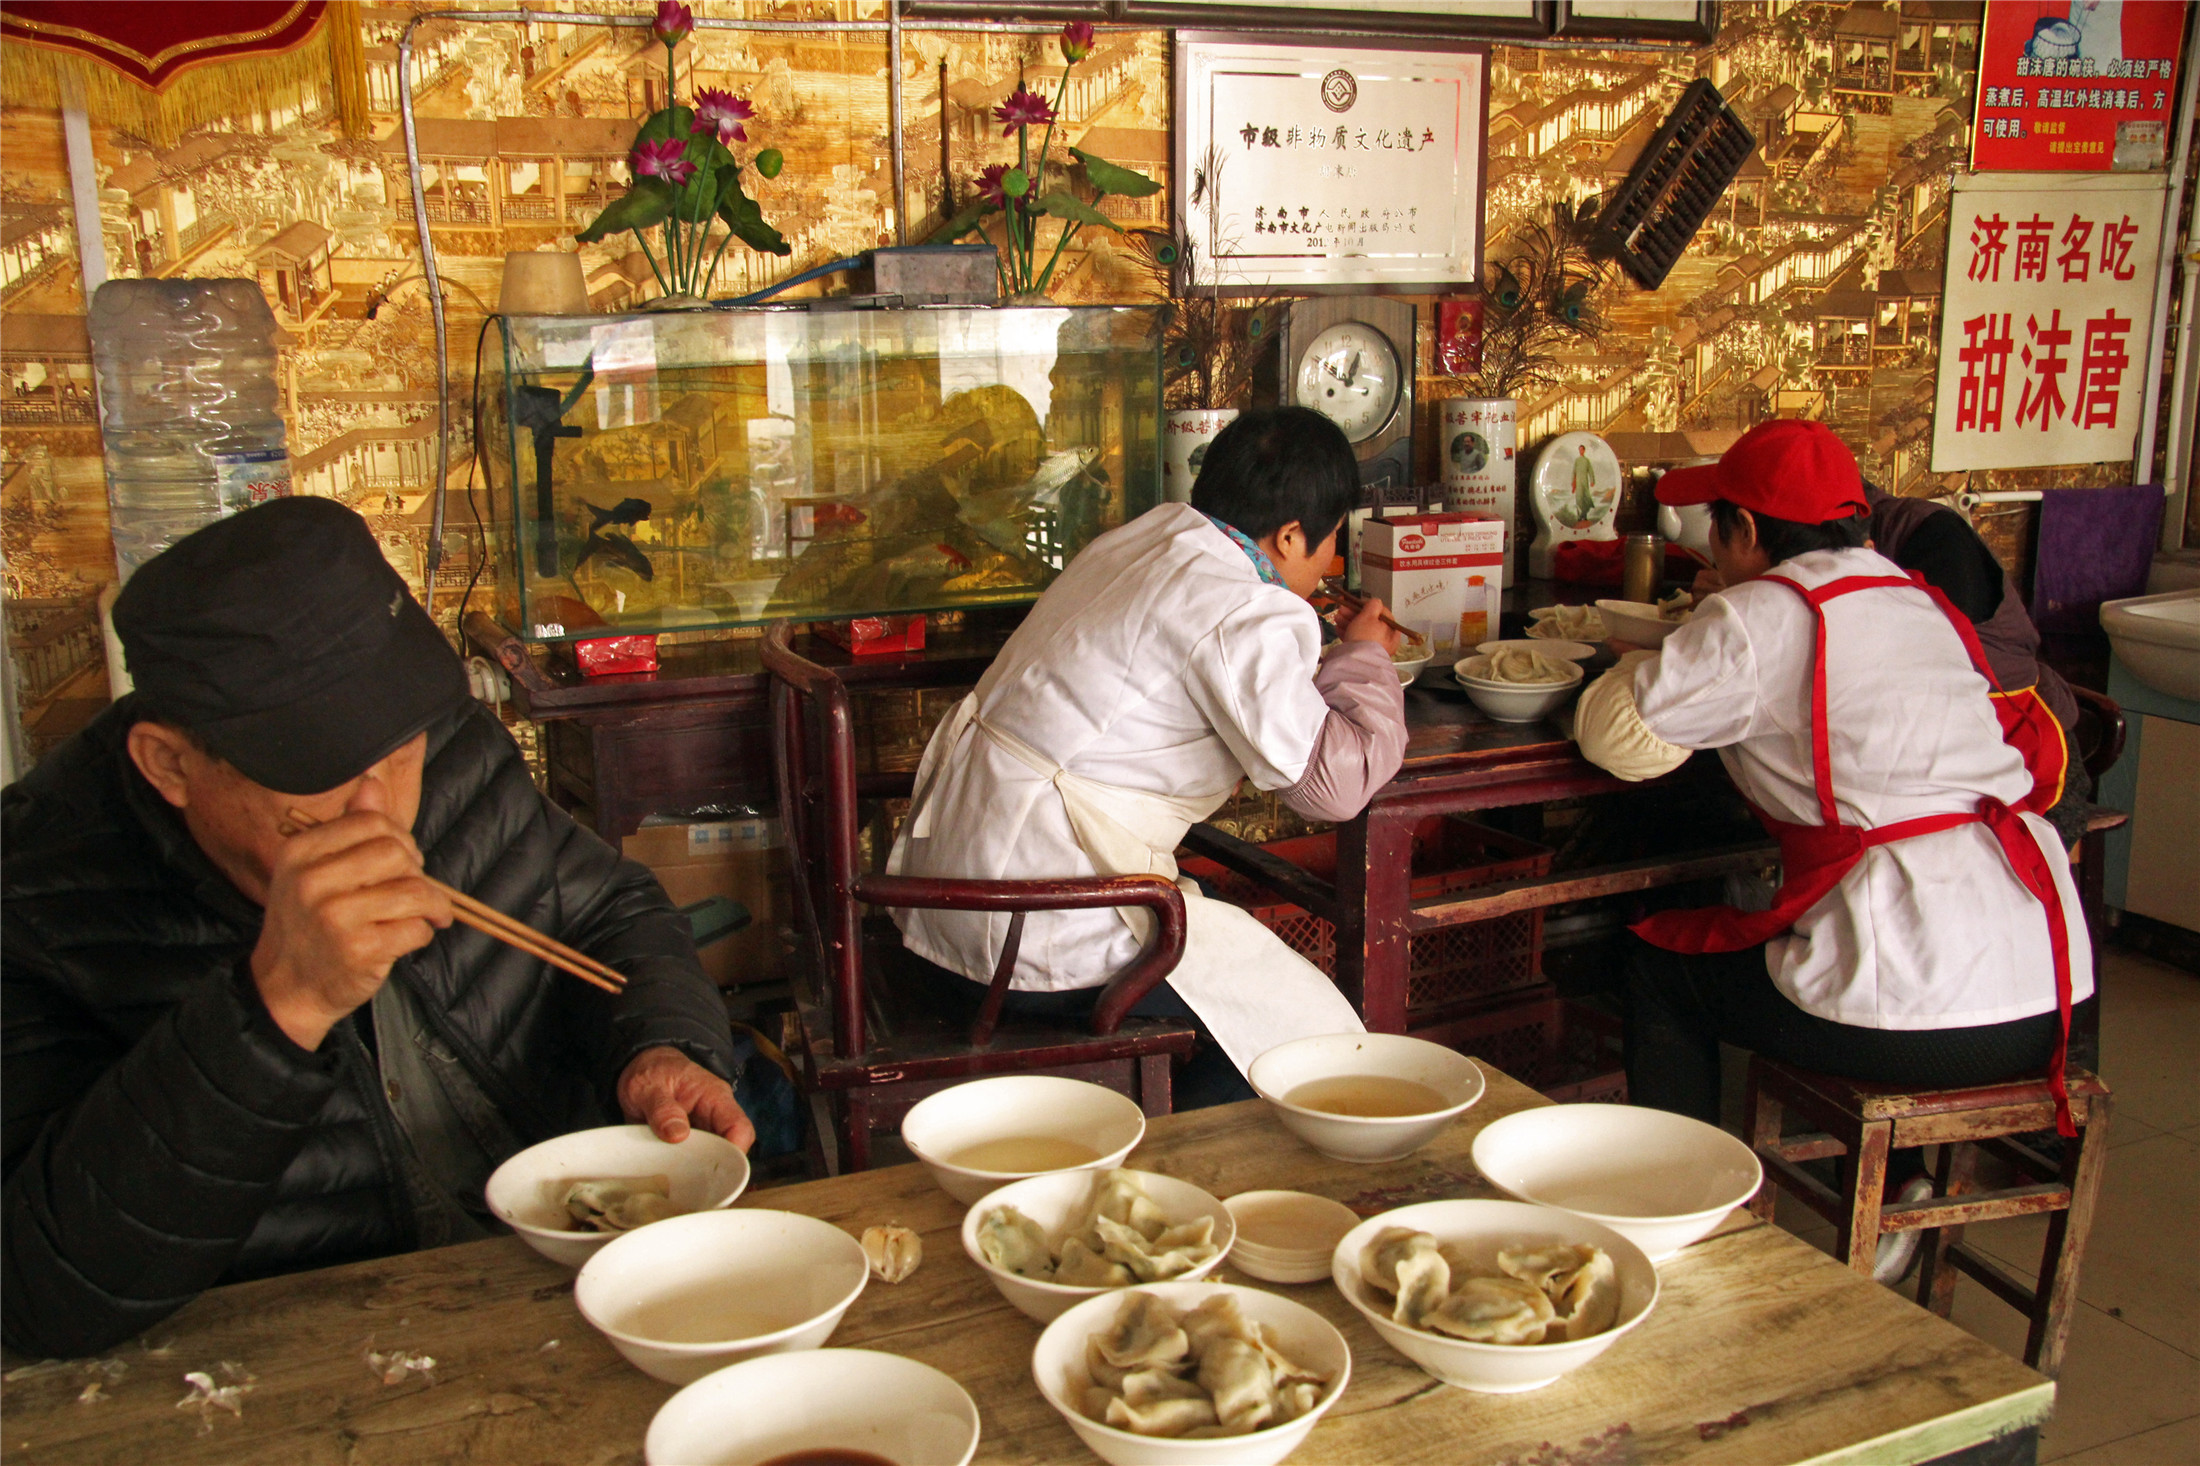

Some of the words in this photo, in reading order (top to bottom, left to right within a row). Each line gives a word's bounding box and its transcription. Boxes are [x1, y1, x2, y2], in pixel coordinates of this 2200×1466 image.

[1984, 87, 2166, 109] 蒸煮后，高温红外线消毒后，方
[1239, 122, 1435, 152] 市级非物质文化遗产
[1983, 118, 2027, 139] 可使用。
[1968, 213, 2139, 283] 济南名吃
[1341, 334, 1352, 347] 12
[1956, 308, 2132, 433] 甜沫唐
[1167, 418, 1233, 435] 阶级苦牢
[1343, 419, 1352, 431] 6
[1362, 411, 1370, 424] 5
